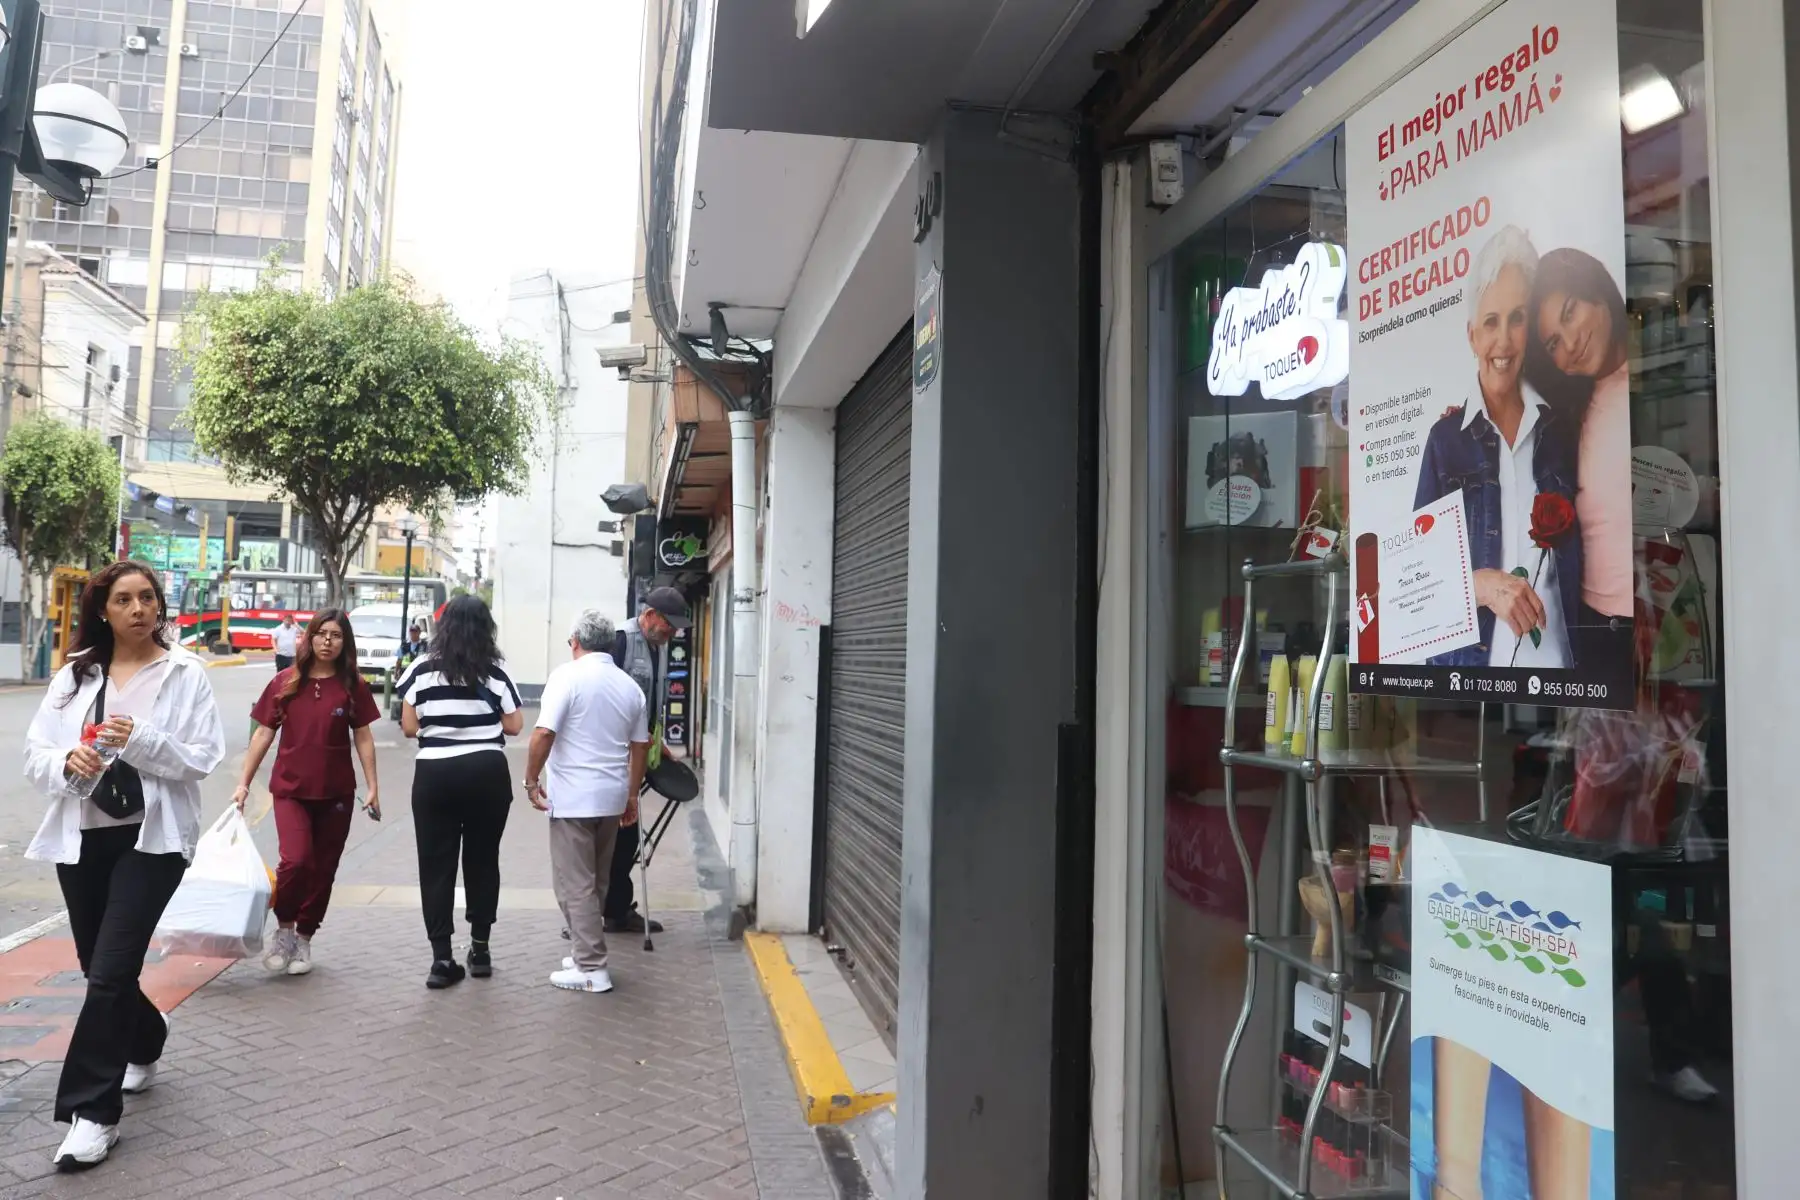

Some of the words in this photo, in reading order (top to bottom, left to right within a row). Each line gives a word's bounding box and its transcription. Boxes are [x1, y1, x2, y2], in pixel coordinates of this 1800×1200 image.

[1378, 123, 1395, 162] El
[1402, 84, 1466, 146] mejor
[1475, 24, 1558, 100] regalo
[1390, 140, 1448, 200] PARA
[1457, 72, 1544, 162] MAMÁ
[1358, 196, 1491, 284] CERTIFICADO
[1359, 288, 1382, 321] DE
[1388, 247, 1470, 308] REGALO
[1239, 261, 1310, 363] probaste?
[1358, 315, 1404, 344] ¡Sorpréndela
[1405, 307, 1427, 324] como
[1429, 288, 1463, 317] quieras!
[1365, 396, 1400, 415] Disponible
[1401, 387, 1432, 405] también
[1365, 422, 1373, 431] en
[1375, 413, 1399, 428] versión
[1400, 404, 1425, 423] digital.
[1365, 437, 1391, 451] Compra
[1393, 430, 1417, 444] online:
[1376, 452, 1389, 465] 955
[1391, 448, 1404, 461] 050
[1406, 444, 1420, 458] 500
[1365, 475, 1370, 483] o
[1372, 472, 1380, 481] en
[1382, 465, 1408, 479] tiendas.
[1382, 676, 1434, 688] www.toquex.pe
[1464, 680, 1475, 690] 01
[1477, 680, 1493, 691] 702
[1495, 681, 1517, 693] 8080
[1543, 682, 1562, 696] 955
[1565, 683, 1584, 697] 050
[1588, 684, 1608, 698] 500
[1429, 957, 1463, 980] Sumerge
[1464, 970, 1477, 985] tus
[1478, 976, 1496, 992] pies
[1497, 984, 1508, 996] en
[1510, 988, 1529, 1004] esta
[1532, 996, 1586, 1025] experiencia
[1454, 984, 1495, 1010] fascinante
[1497, 1004, 1502, 1012] e
